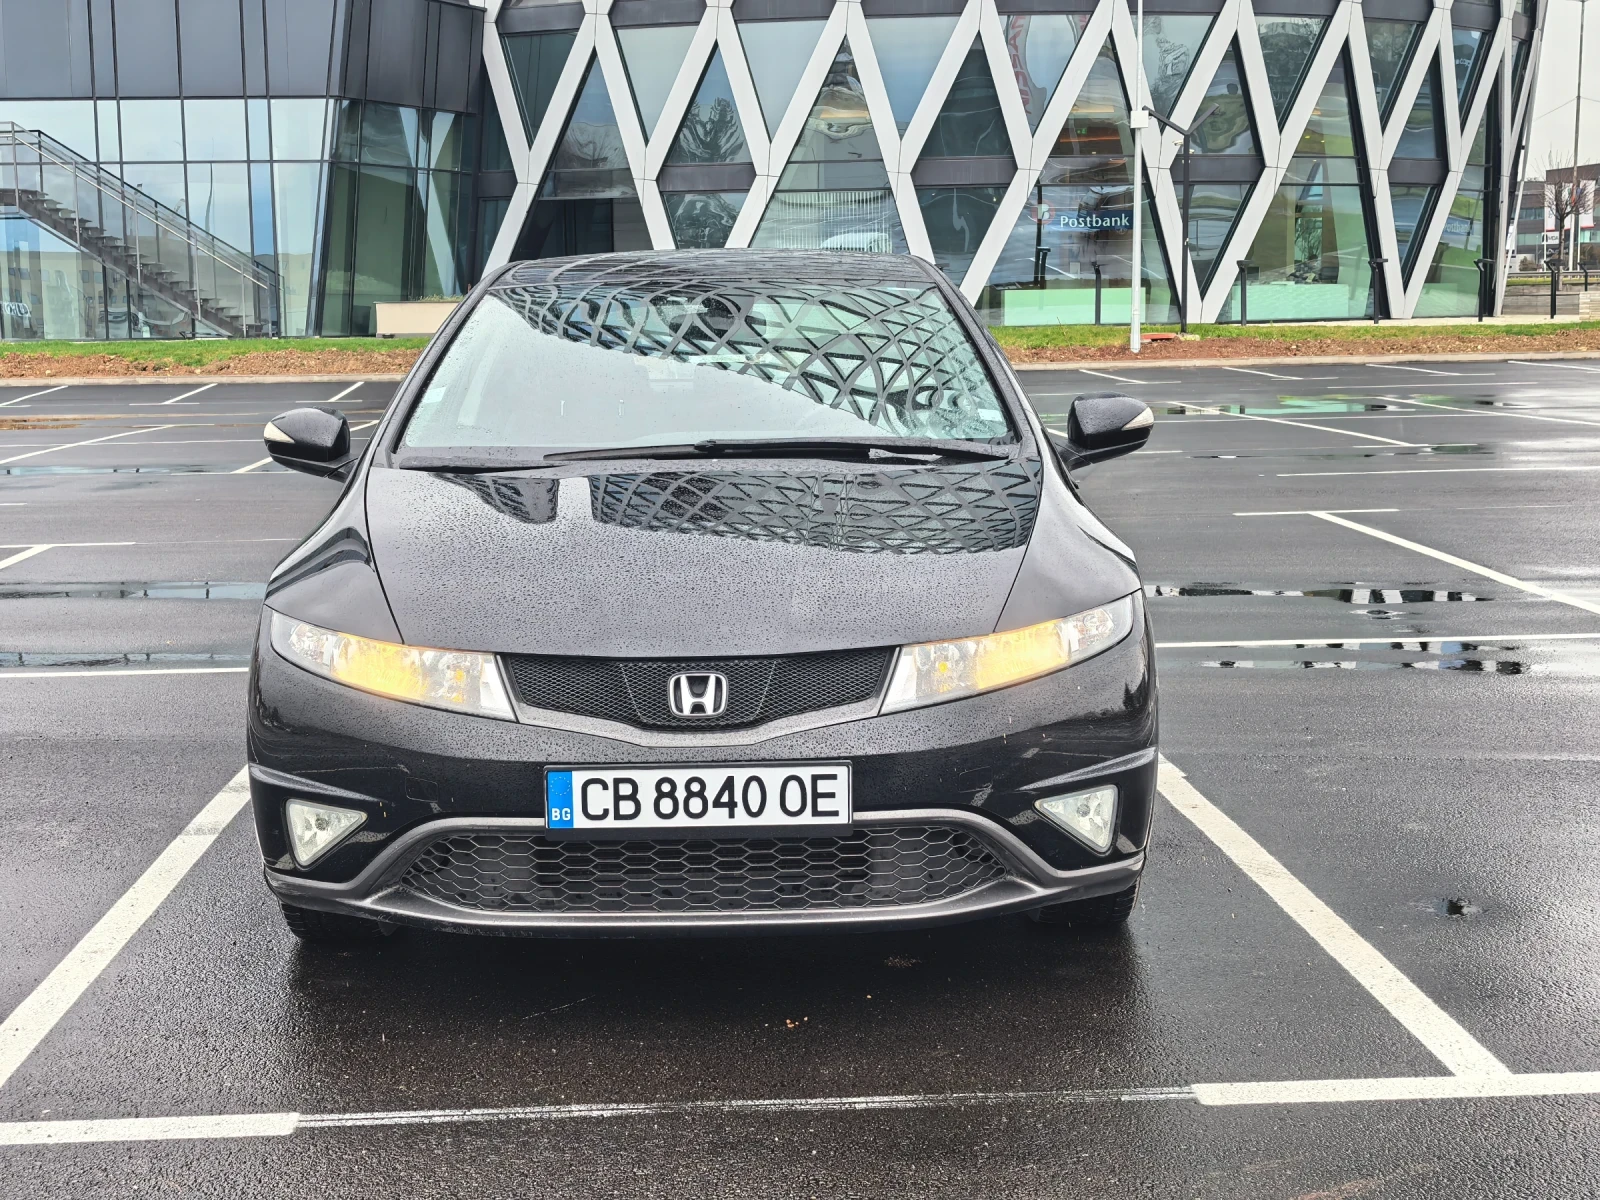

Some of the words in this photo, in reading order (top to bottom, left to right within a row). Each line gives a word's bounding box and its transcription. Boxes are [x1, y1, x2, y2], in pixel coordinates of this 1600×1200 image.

[1060, 213, 1130, 228] Postbank
[581, 777, 641, 821] CB
[653, 775, 767, 820] 8840
[778, 773, 840, 818] OE
[551, 808, 571, 821] BG
